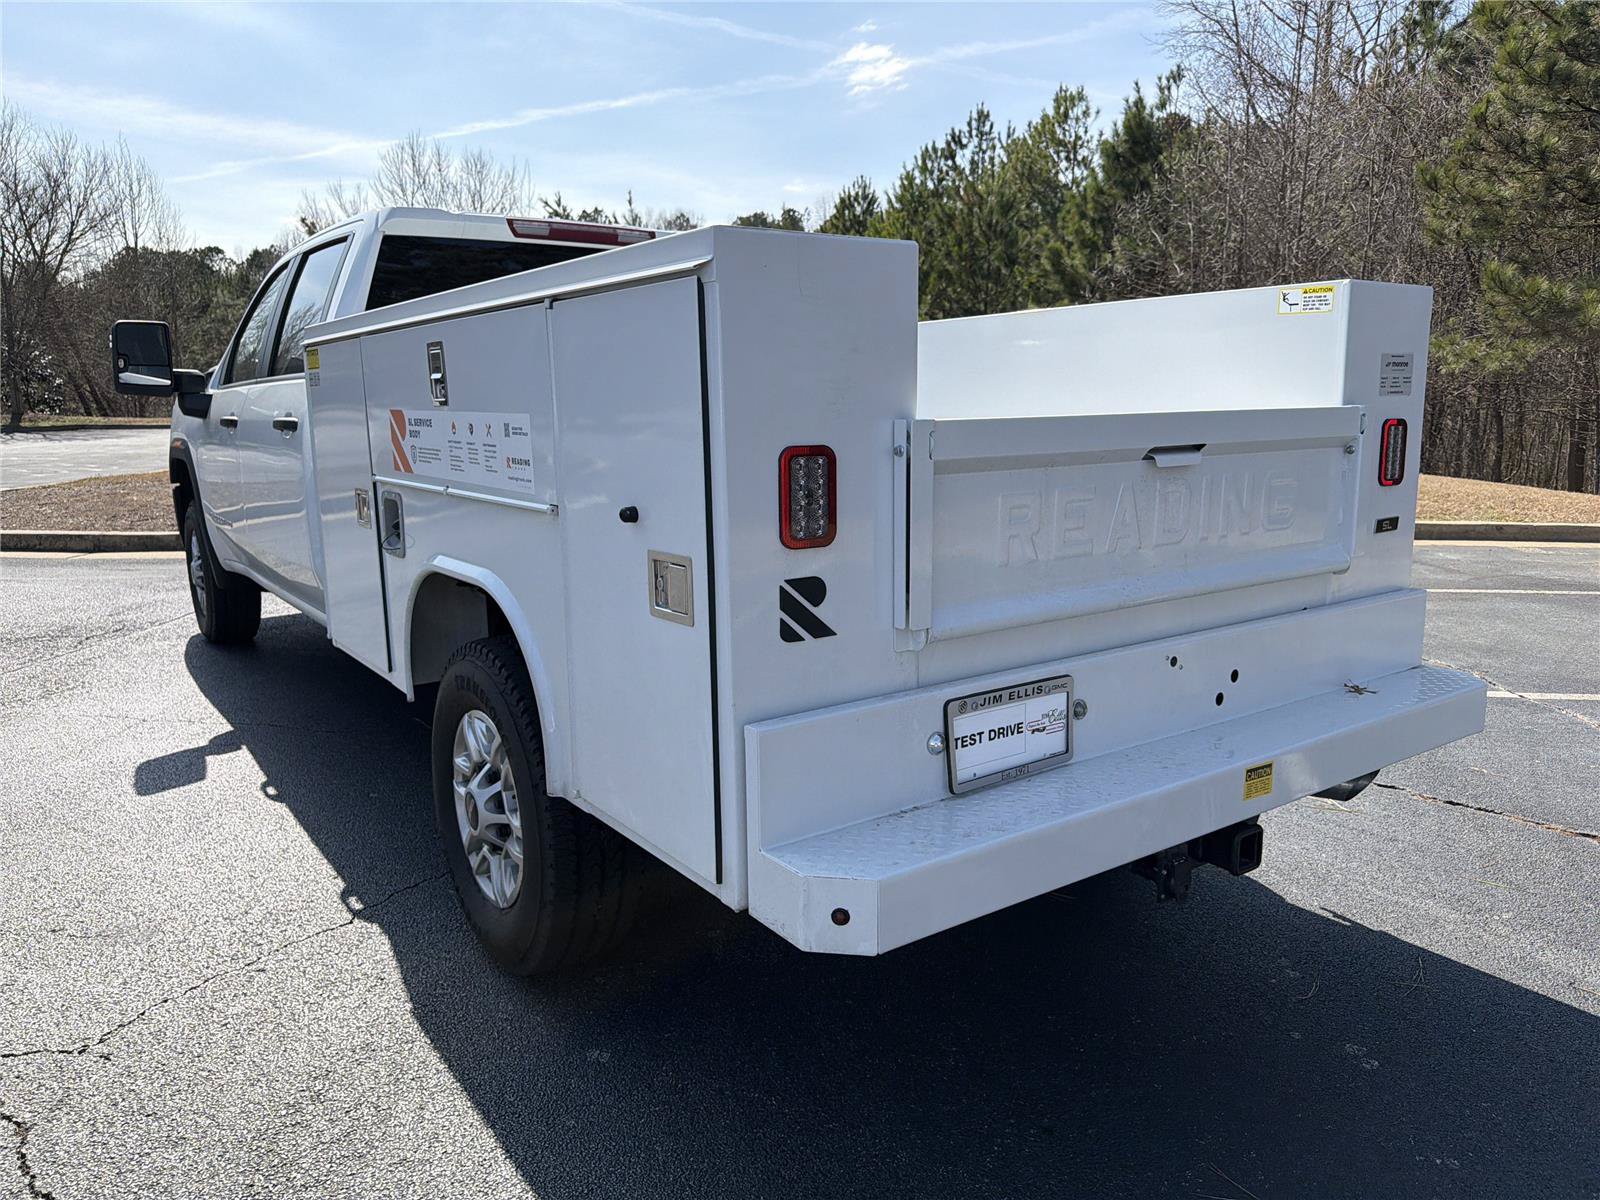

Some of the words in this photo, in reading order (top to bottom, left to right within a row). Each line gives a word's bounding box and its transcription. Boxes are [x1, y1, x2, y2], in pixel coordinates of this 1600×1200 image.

[414, 418, 433, 428] SERVICE
[409, 429, 421, 439] BODY
[511, 457, 531, 467] READING
[998, 471, 1298, 568] READING
[979, 693, 1003, 708] JIM
[1008, 685, 1043, 701] ELLIS
[1051, 682, 1069, 691] GMC
[954, 731, 985, 750] TEST
[988, 721, 1024, 742] DRIVE
[1247, 766, 1271, 780] CAUTION
